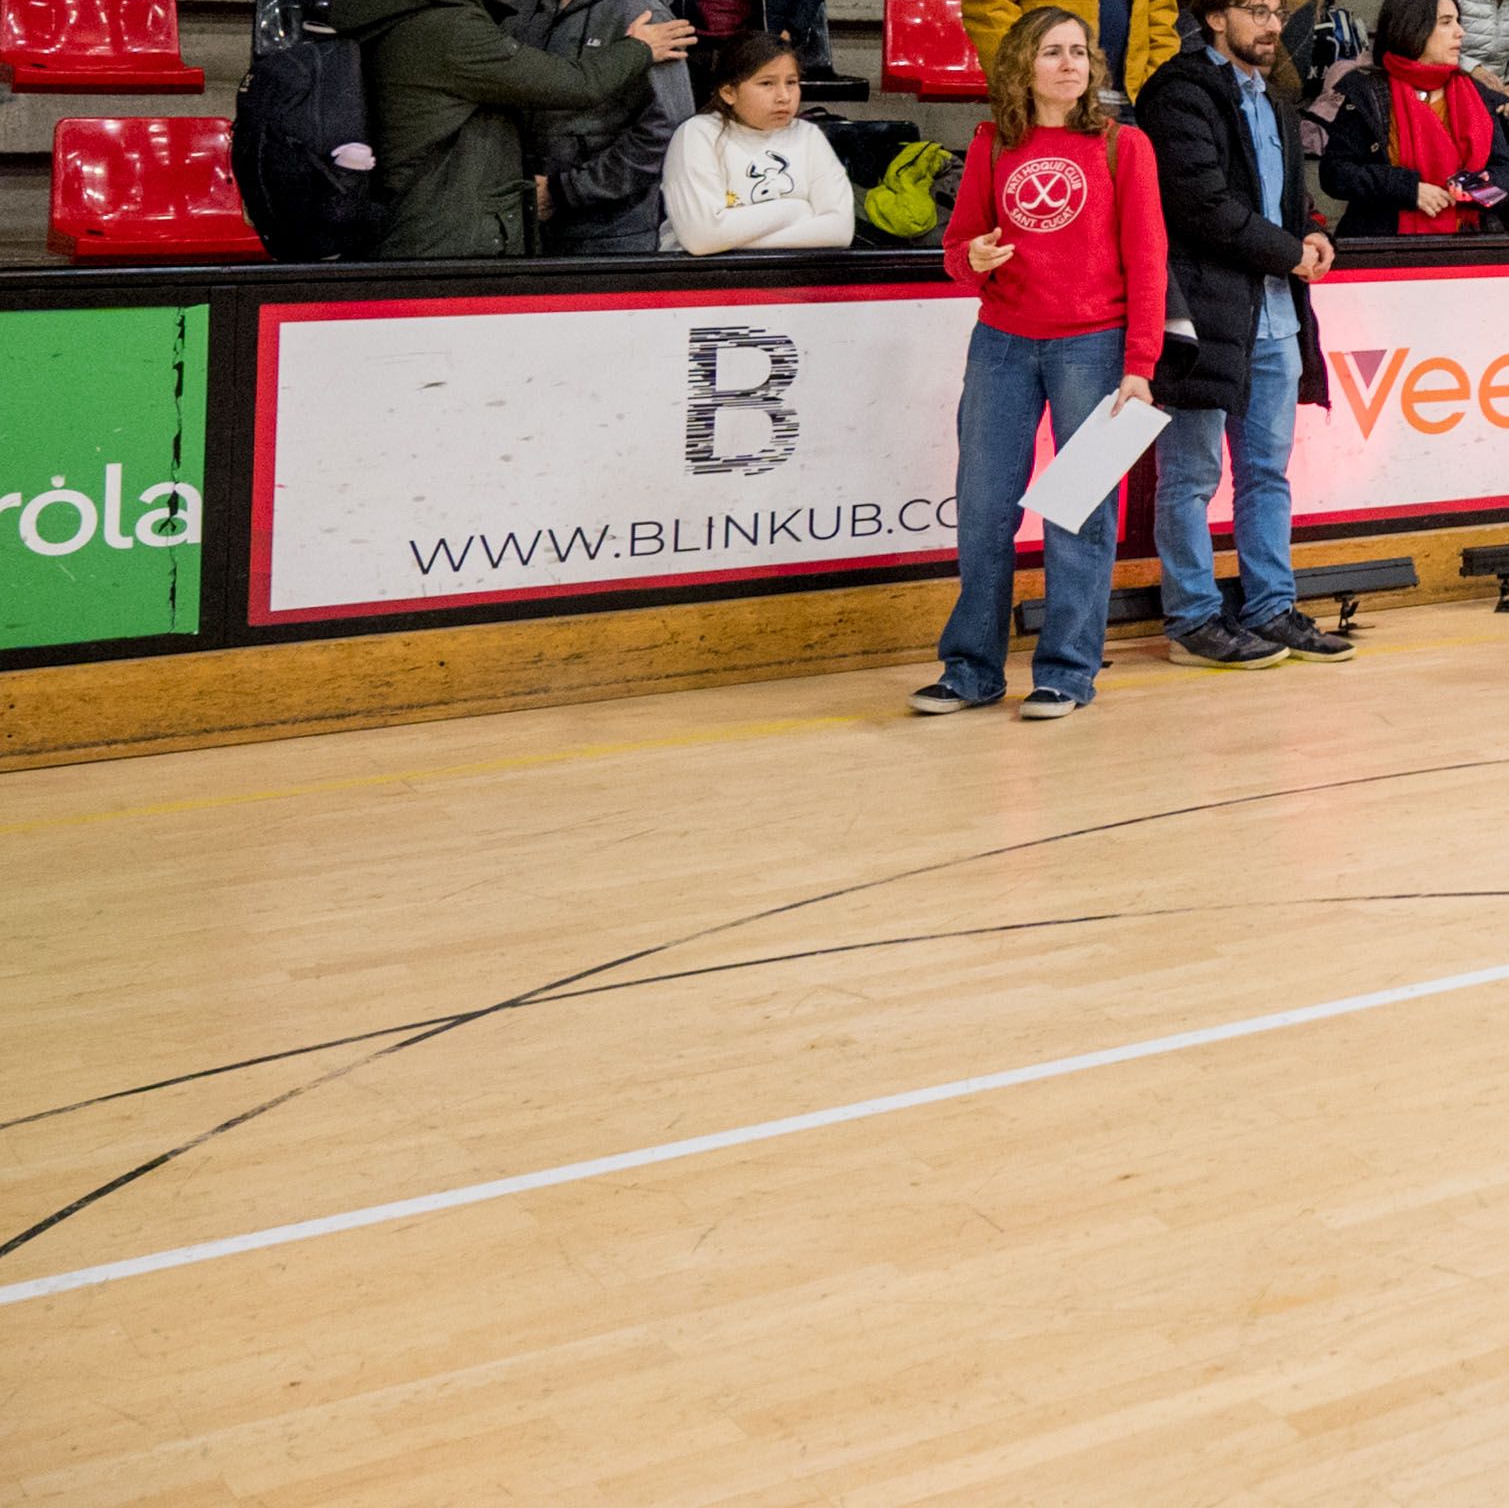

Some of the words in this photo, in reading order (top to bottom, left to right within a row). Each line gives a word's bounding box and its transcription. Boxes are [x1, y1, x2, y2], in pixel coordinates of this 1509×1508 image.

[1022, 161, 1067, 177] HOQUEI
[1064, 166, 1083, 190] CLUB
[1011, 208, 1038, 228] SANT
[1041, 206, 1075, 229] CUGAT
[684, 325, 800, 477] B
